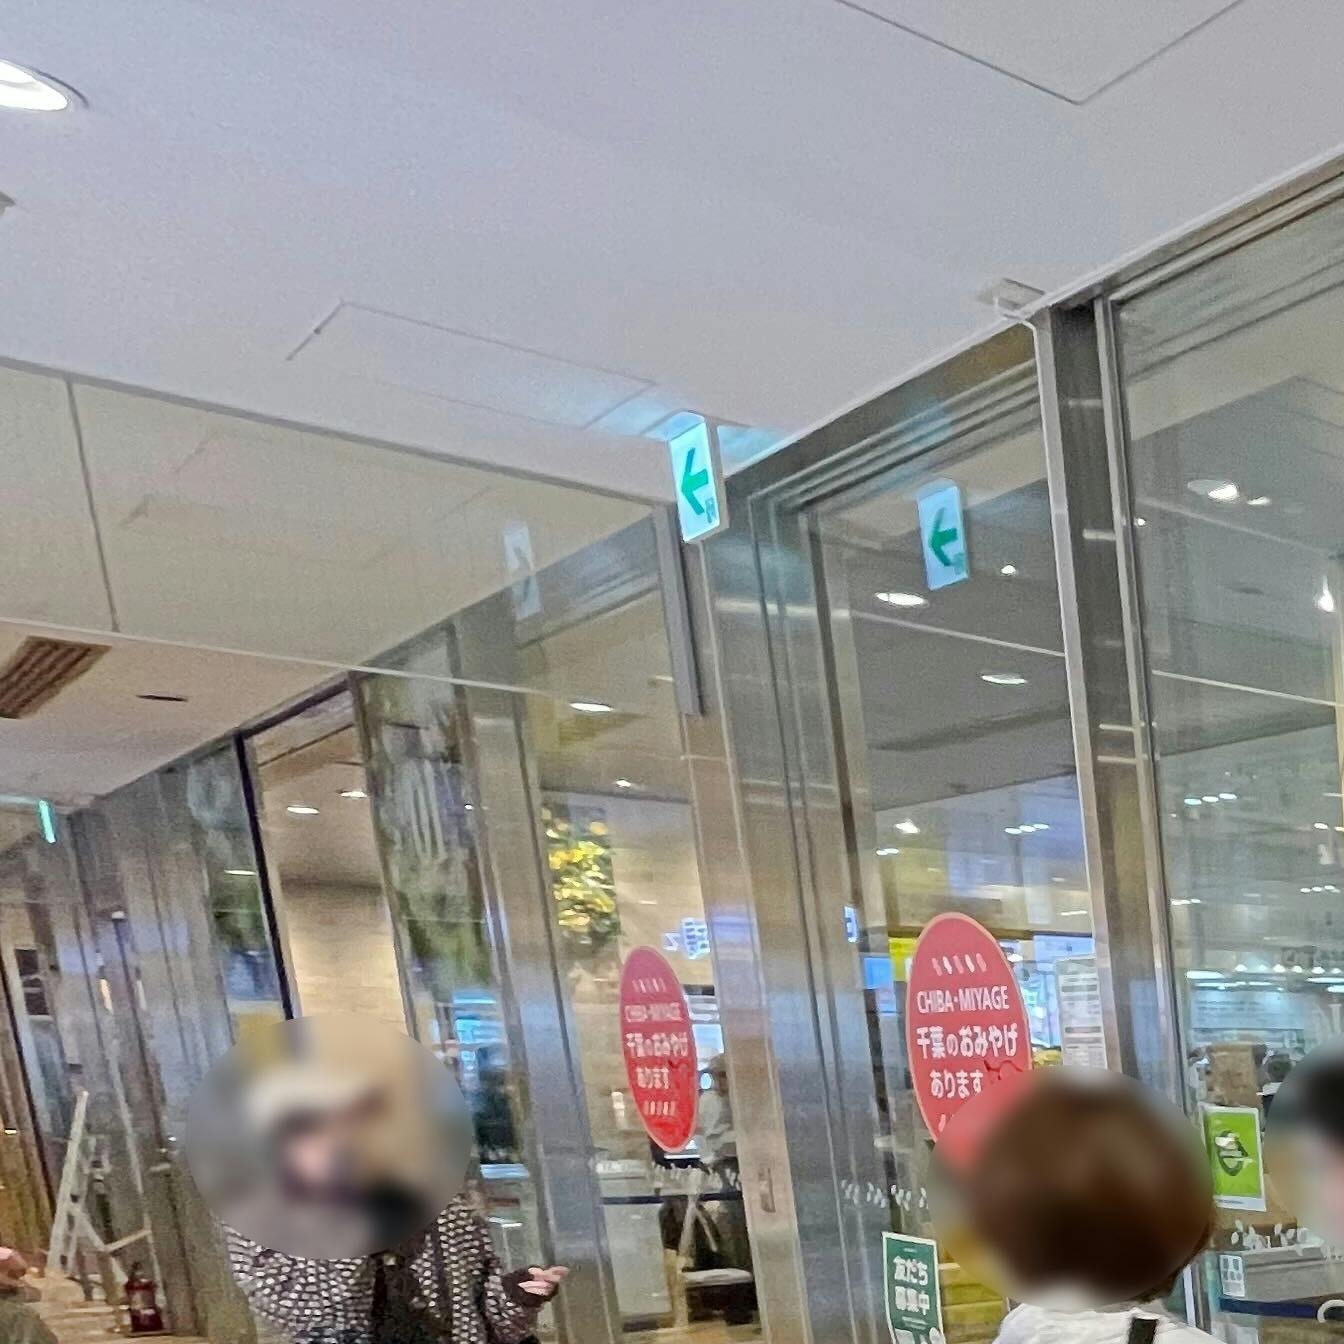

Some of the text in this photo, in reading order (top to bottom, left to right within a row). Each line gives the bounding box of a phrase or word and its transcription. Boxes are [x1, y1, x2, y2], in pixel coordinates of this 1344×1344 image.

[916, 1022, 1018, 1059] 千葉のおみやげ
[929, 1068, 983, 1099] あります
